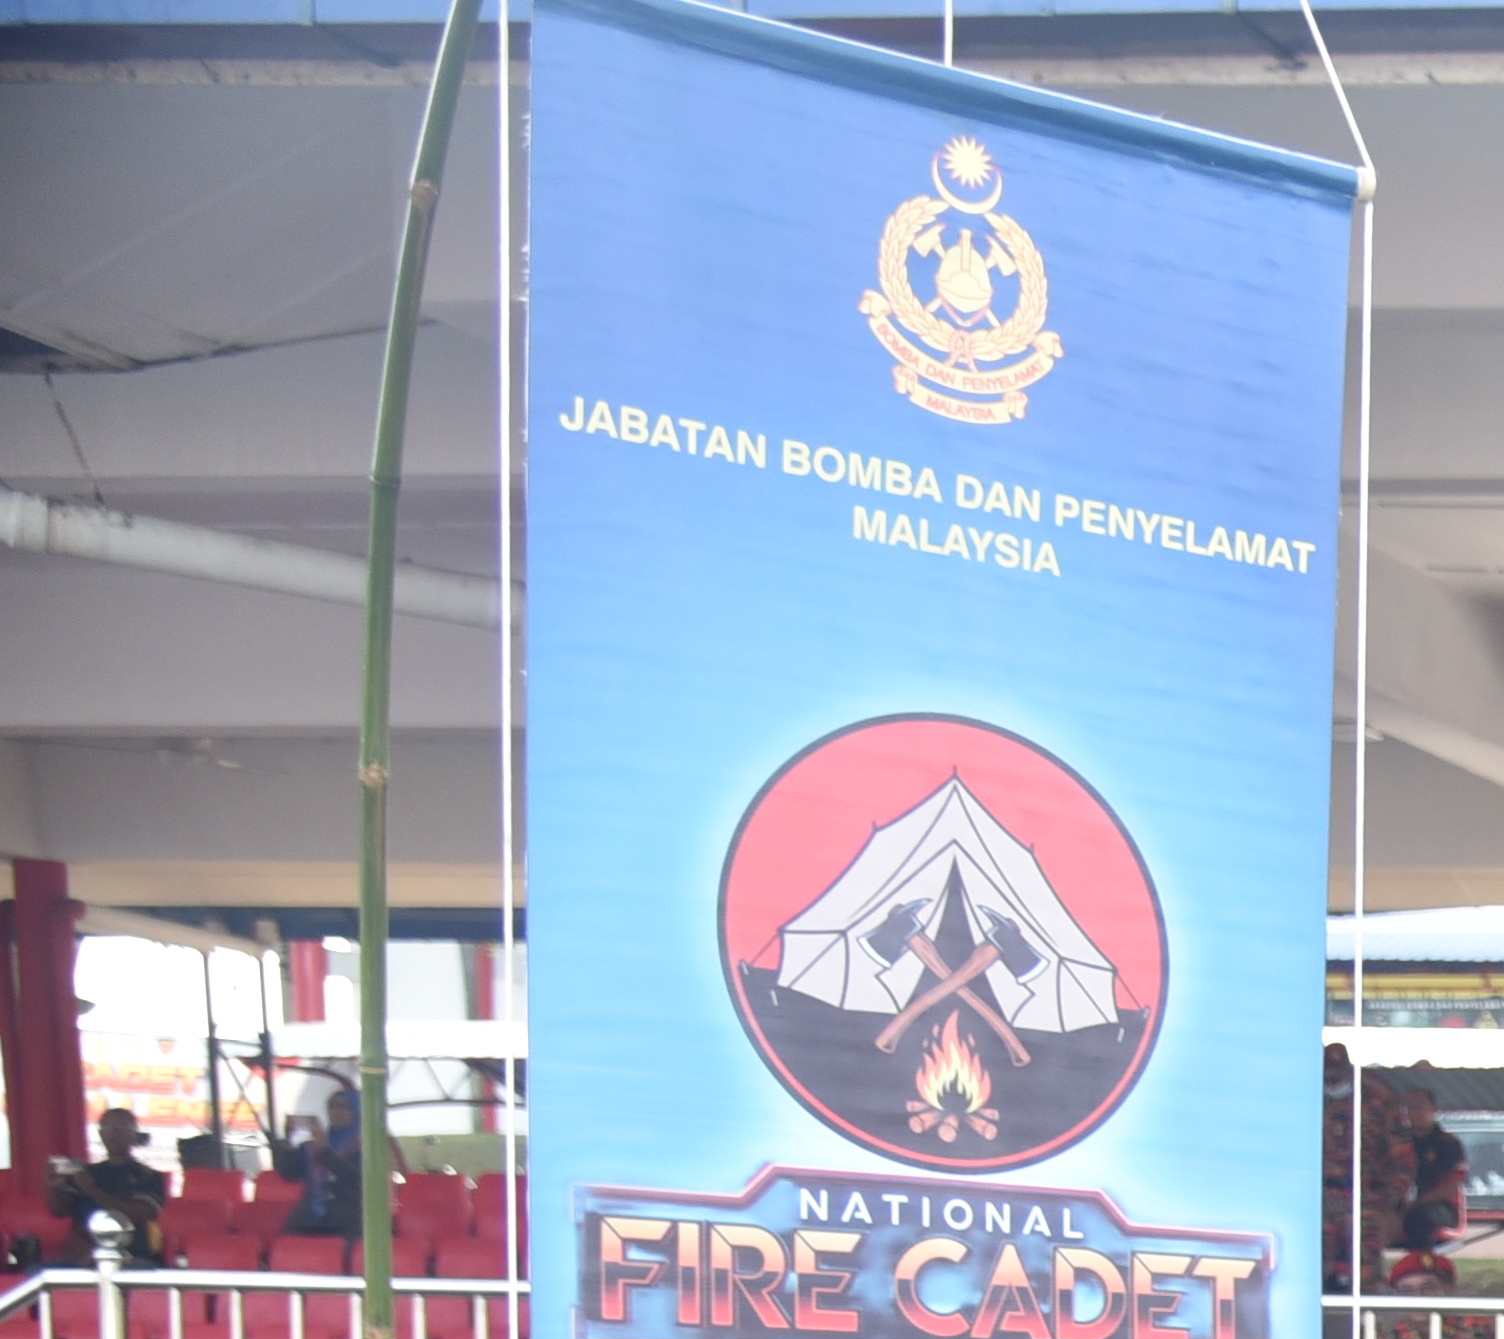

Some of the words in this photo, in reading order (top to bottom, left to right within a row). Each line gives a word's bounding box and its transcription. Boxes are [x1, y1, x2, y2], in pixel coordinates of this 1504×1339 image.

[878, 324, 919, 371] BOMBA
[926, 363, 956, 386] DAN
[963, 359, 1045, 391] PENYELAMAT
[926, 395, 996, 420] MALAYSIA
[559, 395, 767, 469] JABATAN
[782, 438, 944, 504] BOMBA
[955, 473, 1041, 523] DAN
[1054, 493, 1317, 574] PENYELAMAT
[853, 505, 1061, 577] MALAYSIA
[799, 1187, 1085, 1240] NATIONAL
[599, 1214, 864, 1333] FIRE
